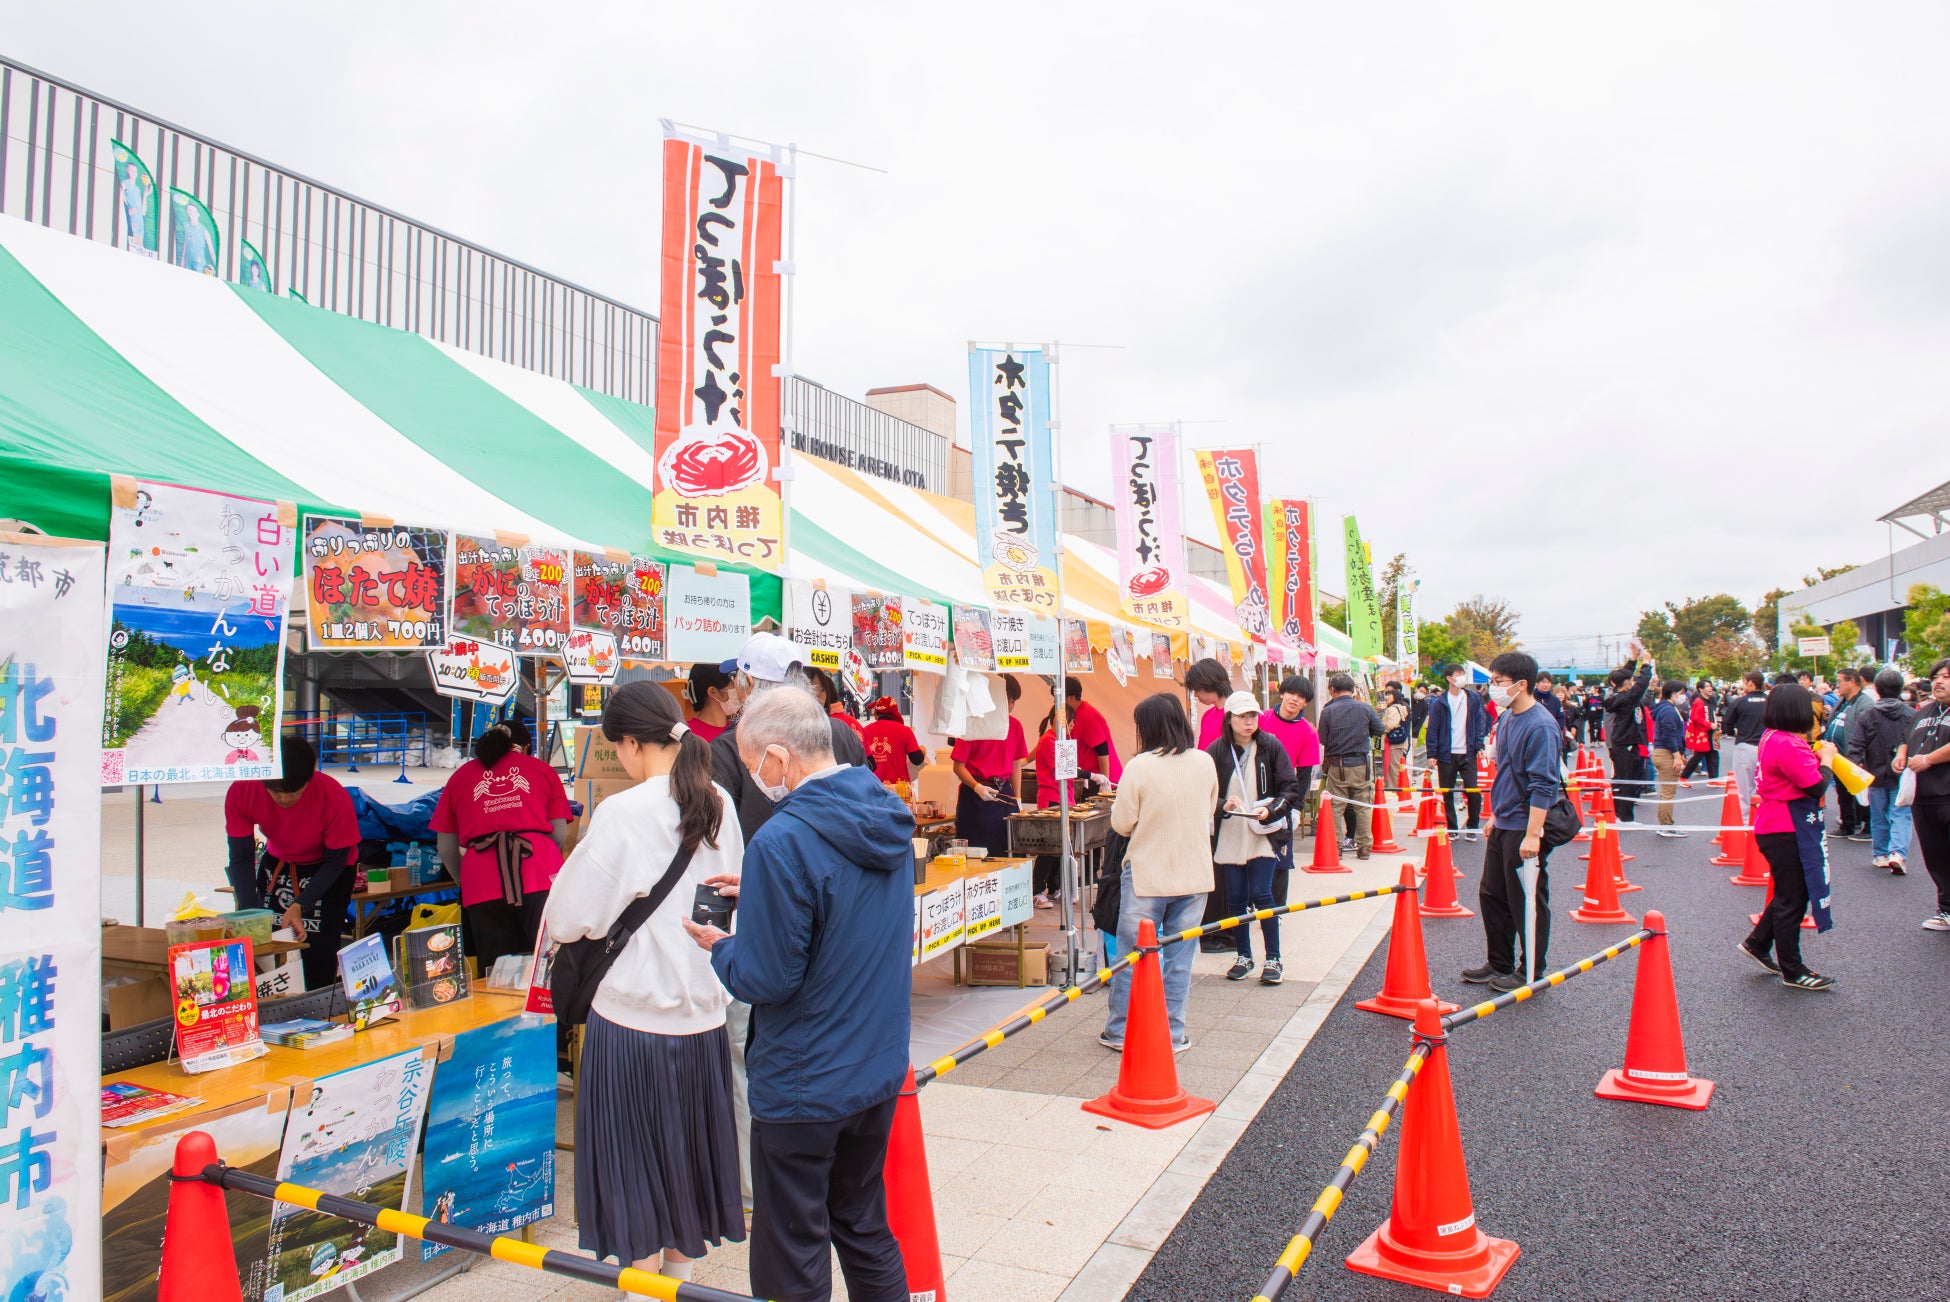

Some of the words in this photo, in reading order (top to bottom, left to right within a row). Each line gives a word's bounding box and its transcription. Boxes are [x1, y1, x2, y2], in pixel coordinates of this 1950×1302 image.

[811, 437, 856, 468] HOUSE
[858, 454, 902, 483] ARENA
[903, 469, 927, 490] OTA
[311, 532, 410, 558] ぷりっぷりの
[313, 562, 439, 612] ほたて焼
[472, 565, 516, 597] かに
[585, 578, 622, 606] かに
[485, 594, 565, 623] てっぽう汁
[684, 594, 735, 608] お持ち帰りの方は
[596, 605, 660, 630] てっぽう汁
[908, 610, 945, 632] てっぽう汁
[321, 622, 383, 642] 1皿2個入
[387, 620, 441, 642] 700円
[518, 628, 567, 648] 400円
[794, 627, 849, 650] お会計はこちら
[914, 633, 940, 649] お渡し口
[620, 634, 661, 655] 400円
[811, 652, 839, 665] CASHER
[909, 651, 922, 660] PICK
[934, 657, 945, 665] HERE
[128, 767, 196, 783] 日本の最北。
[201, 767, 235, 780] 北海道
[238, 765, 272, 779] 稚内市
[0, 662, 55, 910] 北海道
[967, 878, 998, 900] ホタテ焼き
[928, 890, 961, 919] てっぽう汁
[971, 900, 996, 921] お渡し口
[1007, 895, 1028, 911] お渡し口
[932, 912, 959, 936] お渡し口
[967, 926, 978, 936] PICK
[980, 922, 987, 931] UP
[988, 917, 1001, 928] HERE
[928, 940, 940, 951] PICK
[943, 935, 950, 944] UP
[201, 1001, 252, 1020] 最北のこだわり
[0, 955, 57, 1210] 稚内市
[501, 1056, 513, 1100] 旅って、
[386, 1057, 424, 1169] 宗谷丘陵、
[483, 1062, 496, 1150] こういう場所に
[469, 1065, 486, 1173] 行くことだと思う。
[511, 1208, 541, 1229] 稚内市
[370, 1252, 396, 1270] 稚内市
